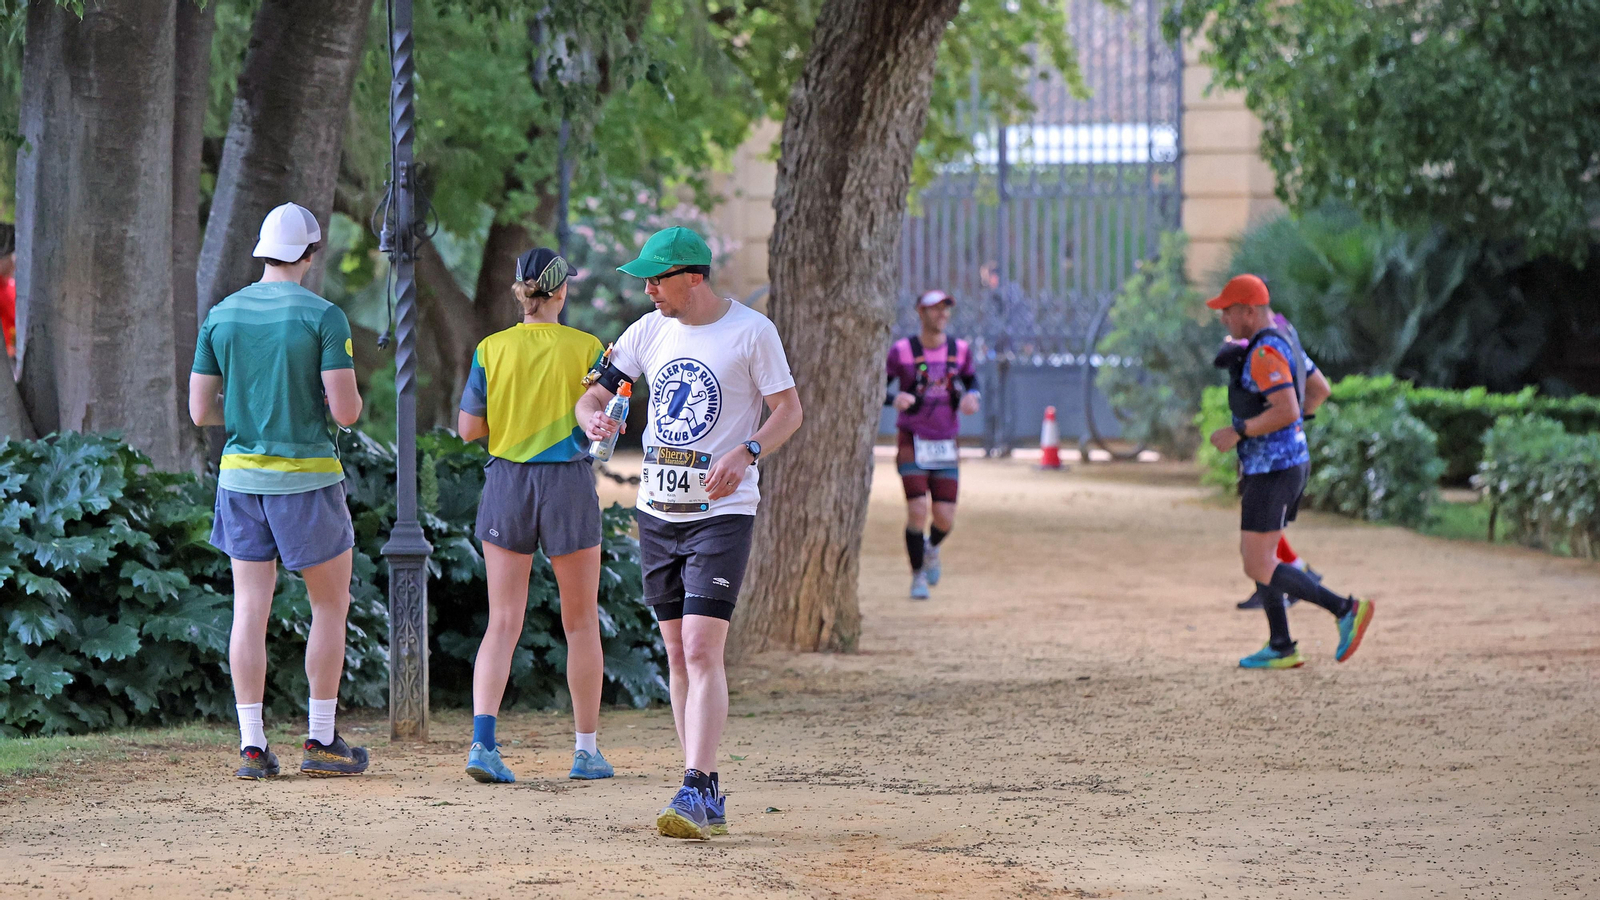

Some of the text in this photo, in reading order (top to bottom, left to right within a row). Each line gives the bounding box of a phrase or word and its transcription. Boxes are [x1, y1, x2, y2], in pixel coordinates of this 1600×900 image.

[699, 370, 718, 422] RUNNING
[662, 429, 689, 441] CLUB
[660, 448, 692, 463] Sherry
[656, 468, 691, 493] 194
